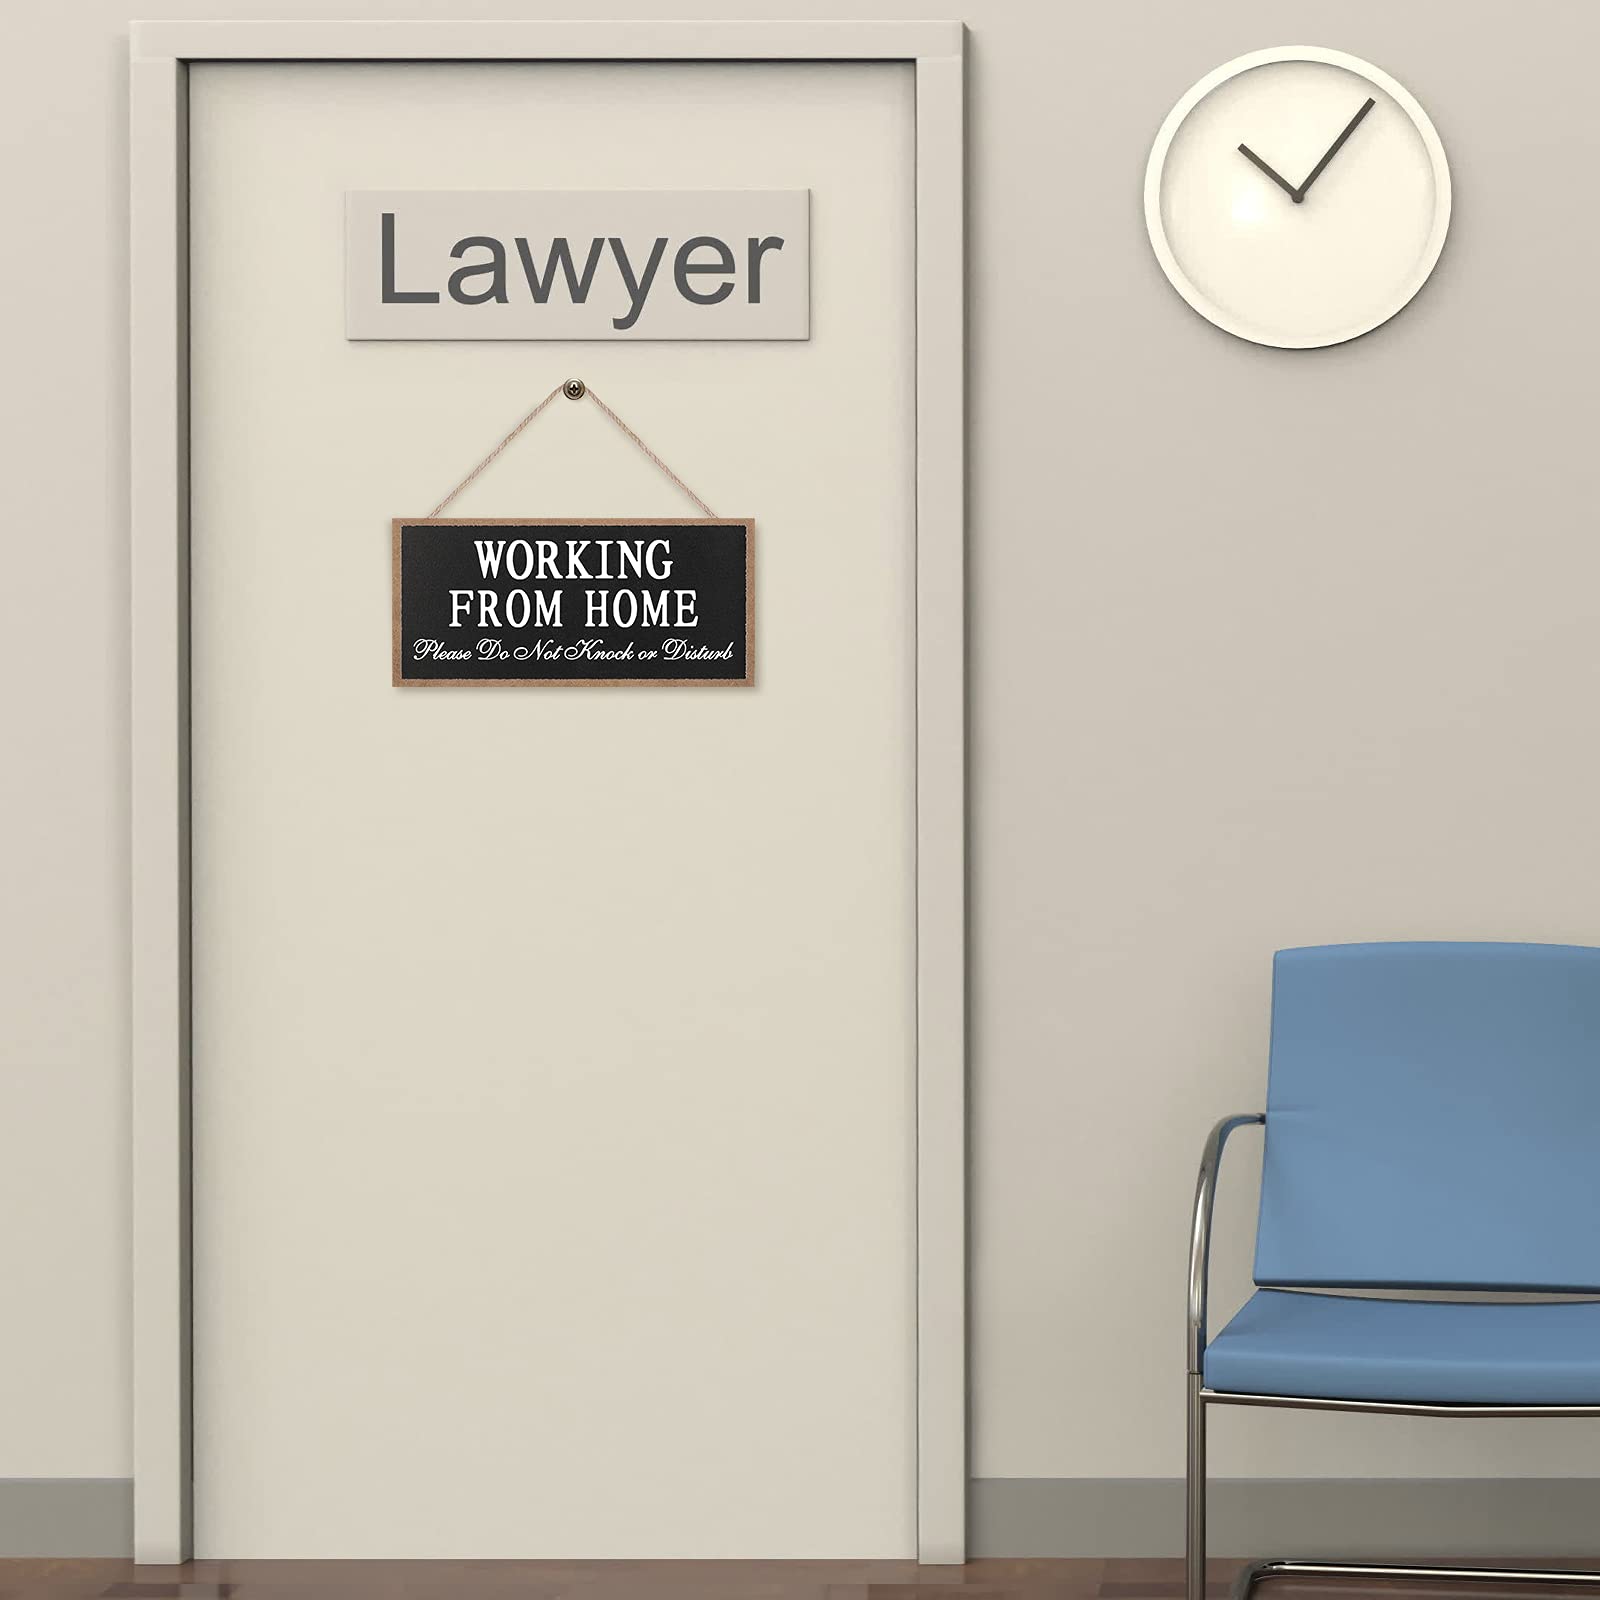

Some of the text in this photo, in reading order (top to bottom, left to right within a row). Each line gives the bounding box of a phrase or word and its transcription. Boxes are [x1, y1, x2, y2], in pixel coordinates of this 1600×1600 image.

[381, 212, 784, 330] Lawyer
[473, 539, 674, 579] WORKING
[448, 589, 699, 627] FROM HOME
[413, 638, 734, 660] Please Do Not Knock or Disturb
